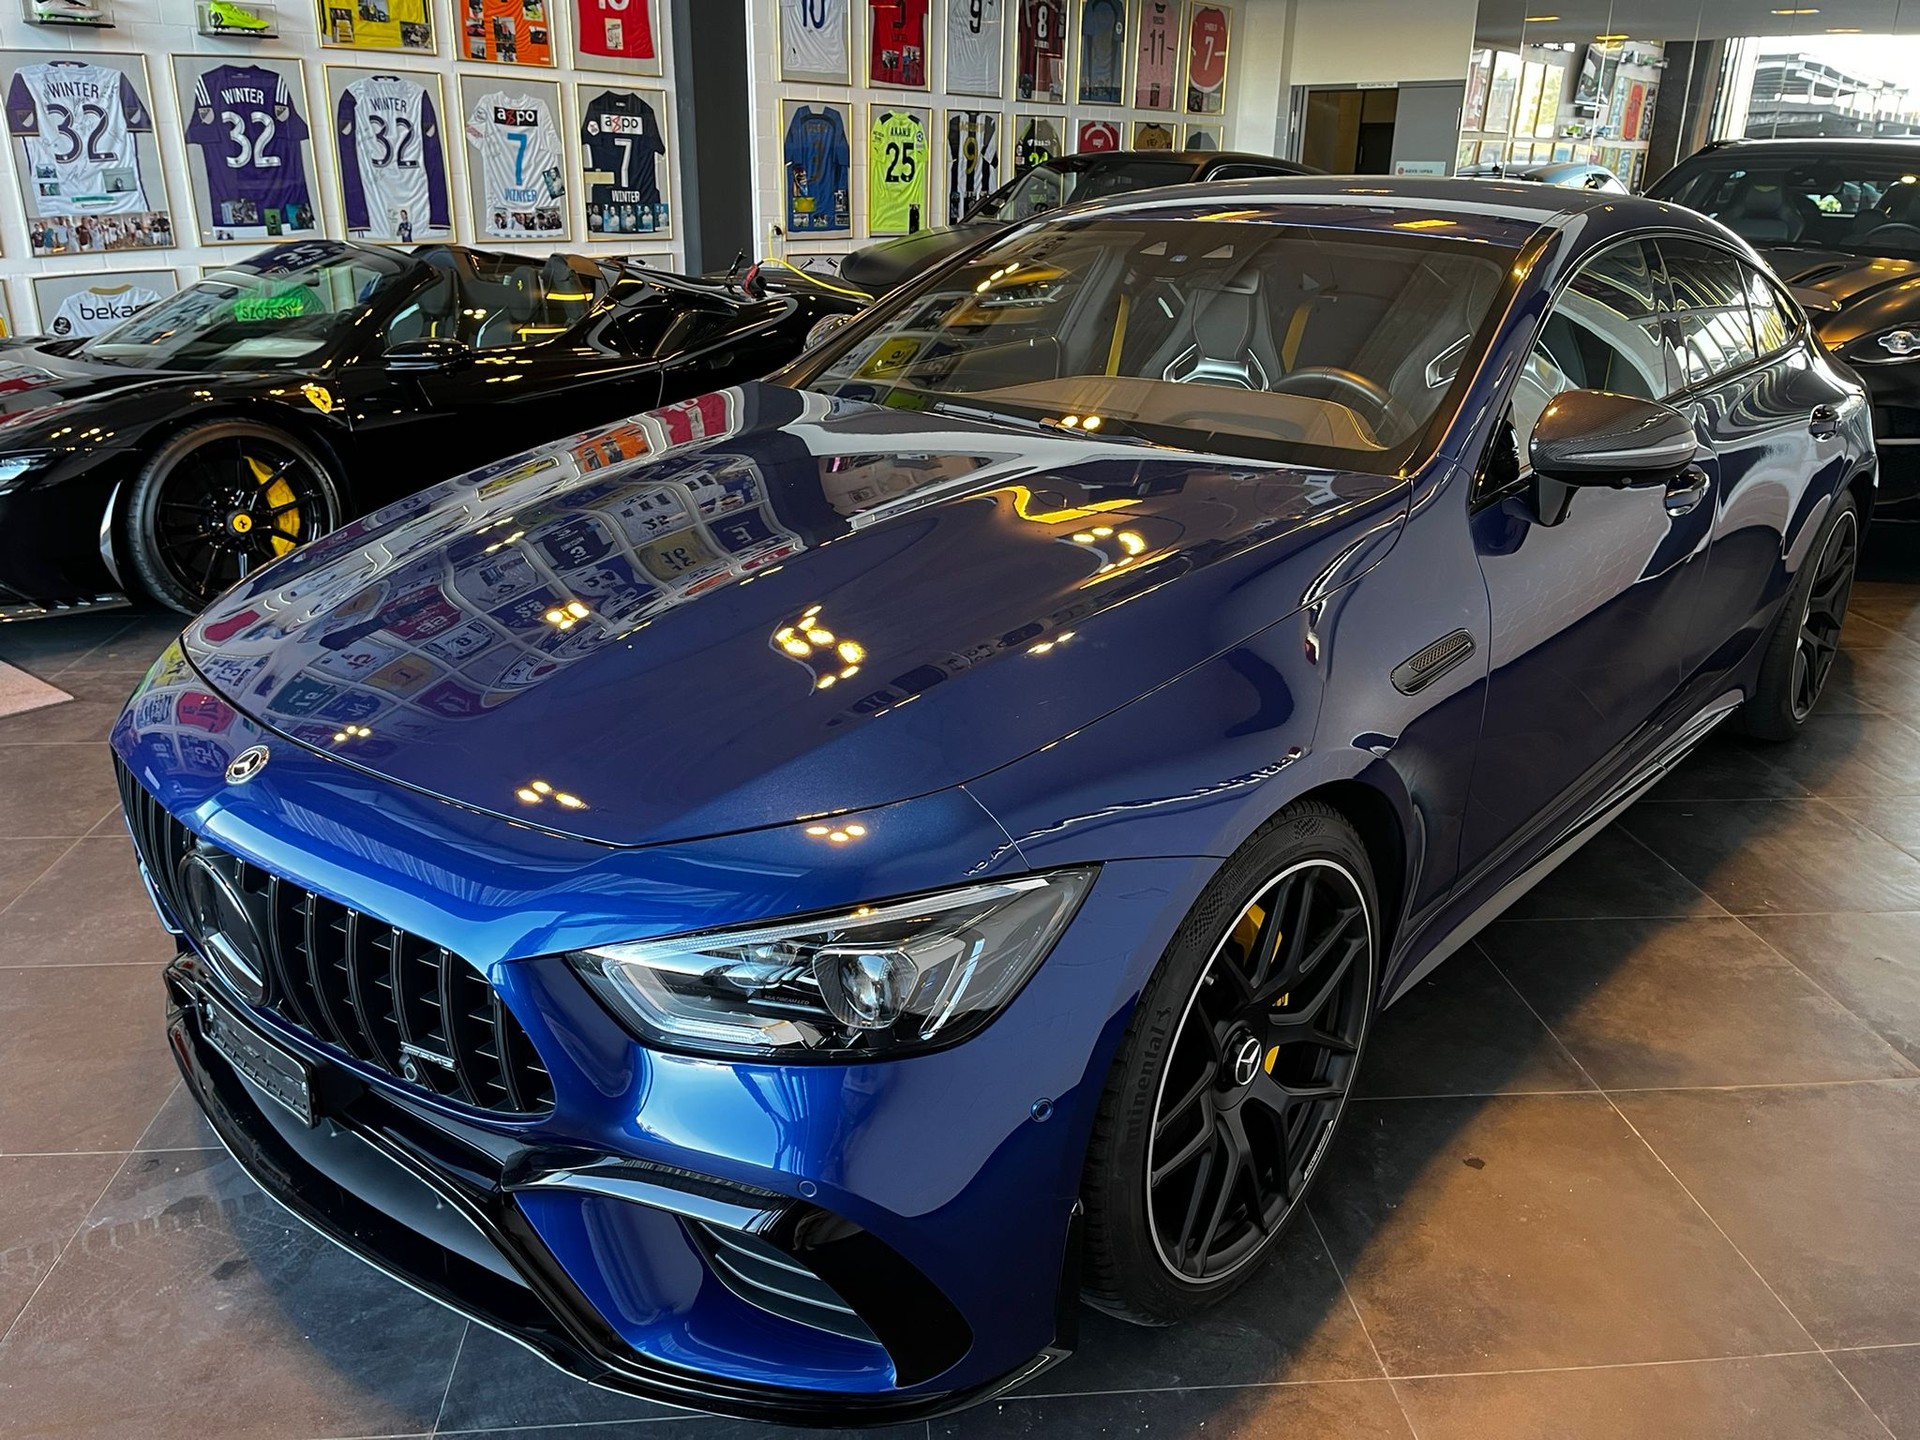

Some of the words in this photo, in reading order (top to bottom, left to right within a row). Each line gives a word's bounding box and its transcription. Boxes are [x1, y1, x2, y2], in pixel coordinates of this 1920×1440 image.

[1037, 5, 1048, 38] 8
[1205, 36, 1215, 71] 7
[47, 81, 100, 99] WINTER
[221, 87, 264, 105] WINTER
[370, 97, 407, 113] WINTER
[46, 103, 119, 164] 32
[221, 111, 281, 168] 32
[369, 115, 420, 169] 32
[507, 132, 527, 186] 7
[614, 138, 632, 188] 7
[885, 142, 915, 182] 25
[963, 136, 978, 175] 9
[504, 188, 538, 202] WINTER
[611, 190, 640, 203] WINTER
[1121, 1024, 1166, 1157] ntinental
